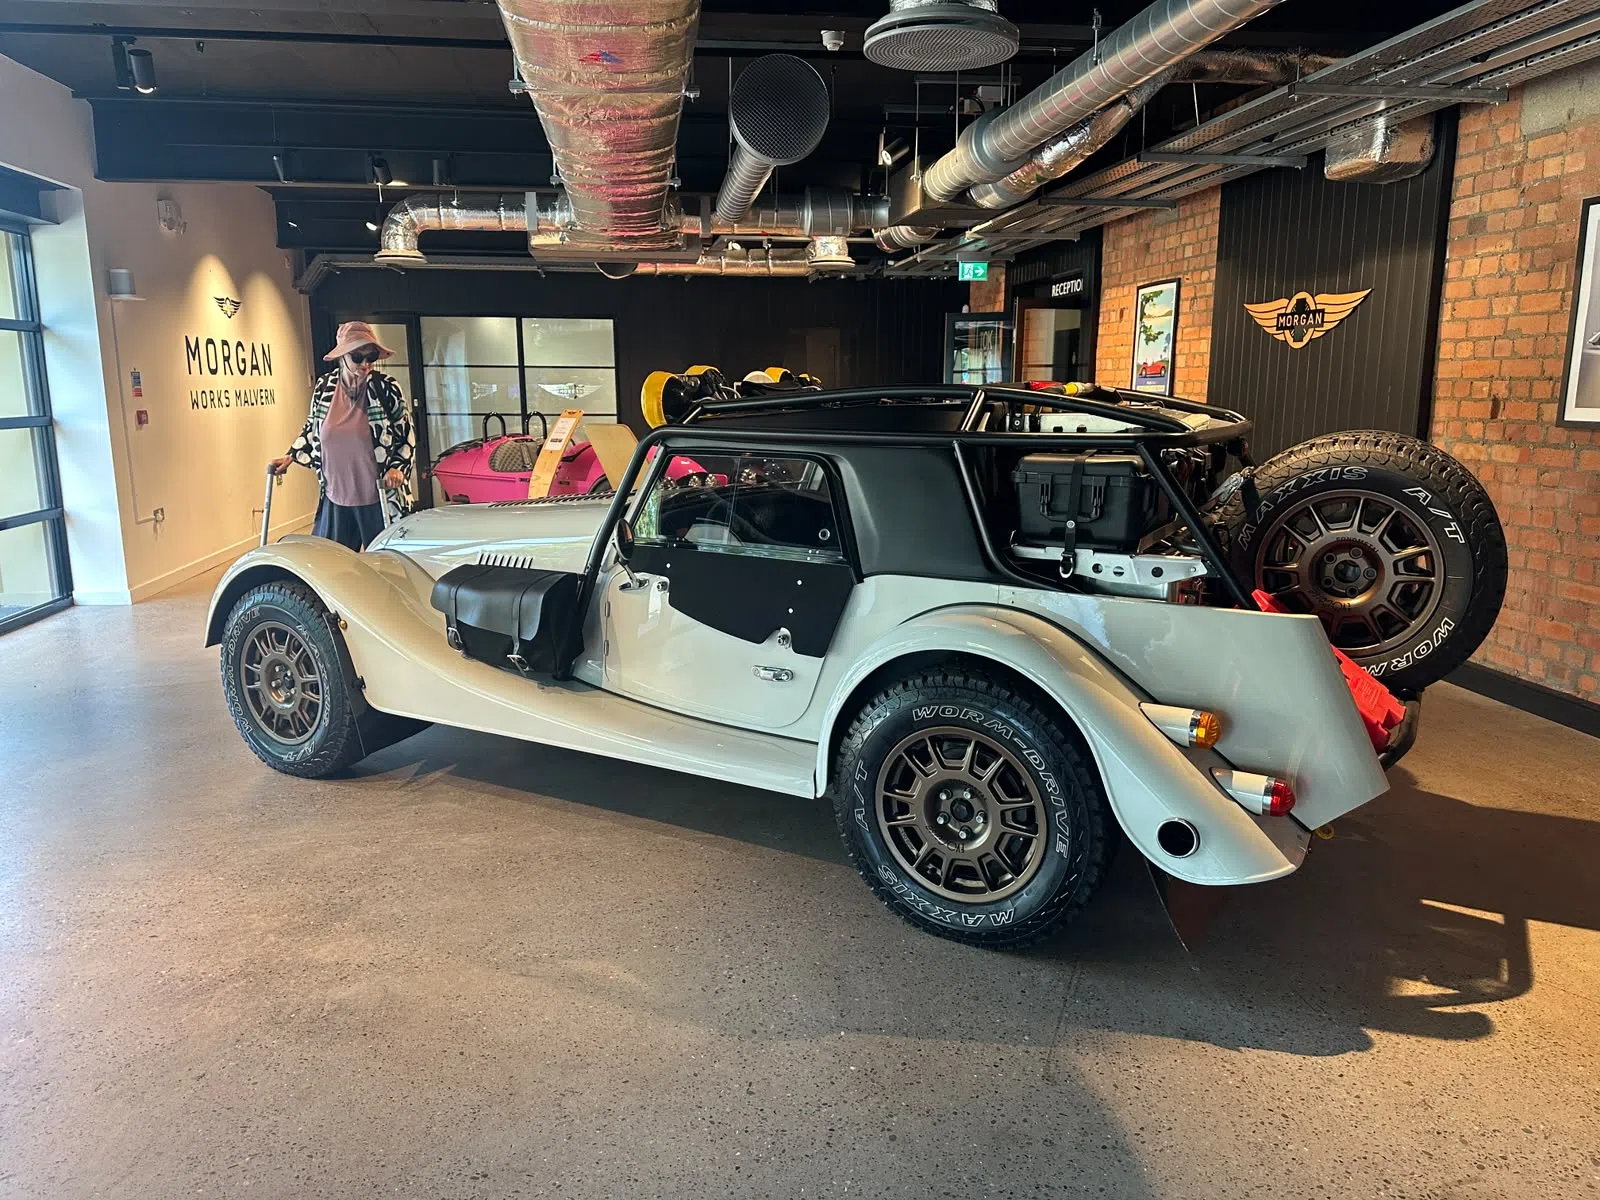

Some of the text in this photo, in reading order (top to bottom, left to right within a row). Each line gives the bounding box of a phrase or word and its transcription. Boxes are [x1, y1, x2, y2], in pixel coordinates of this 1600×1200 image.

[1277, 312, 1323, 328] MORGAN
[184, 335, 273, 376] MORGAN
[190, 388, 276, 410] WORKS MALVERN
[1237, 466, 1369, 551] MAXXIS
[1402, 486, 1466, 544] A/T
[226, 606, 261, 734] WORM-DRIVE
[853, 759, 870, 832] A/T
[912, 705, 1071, 858] WORM-DRIVE
[877, 864, 1016, 927] MAXXIS
